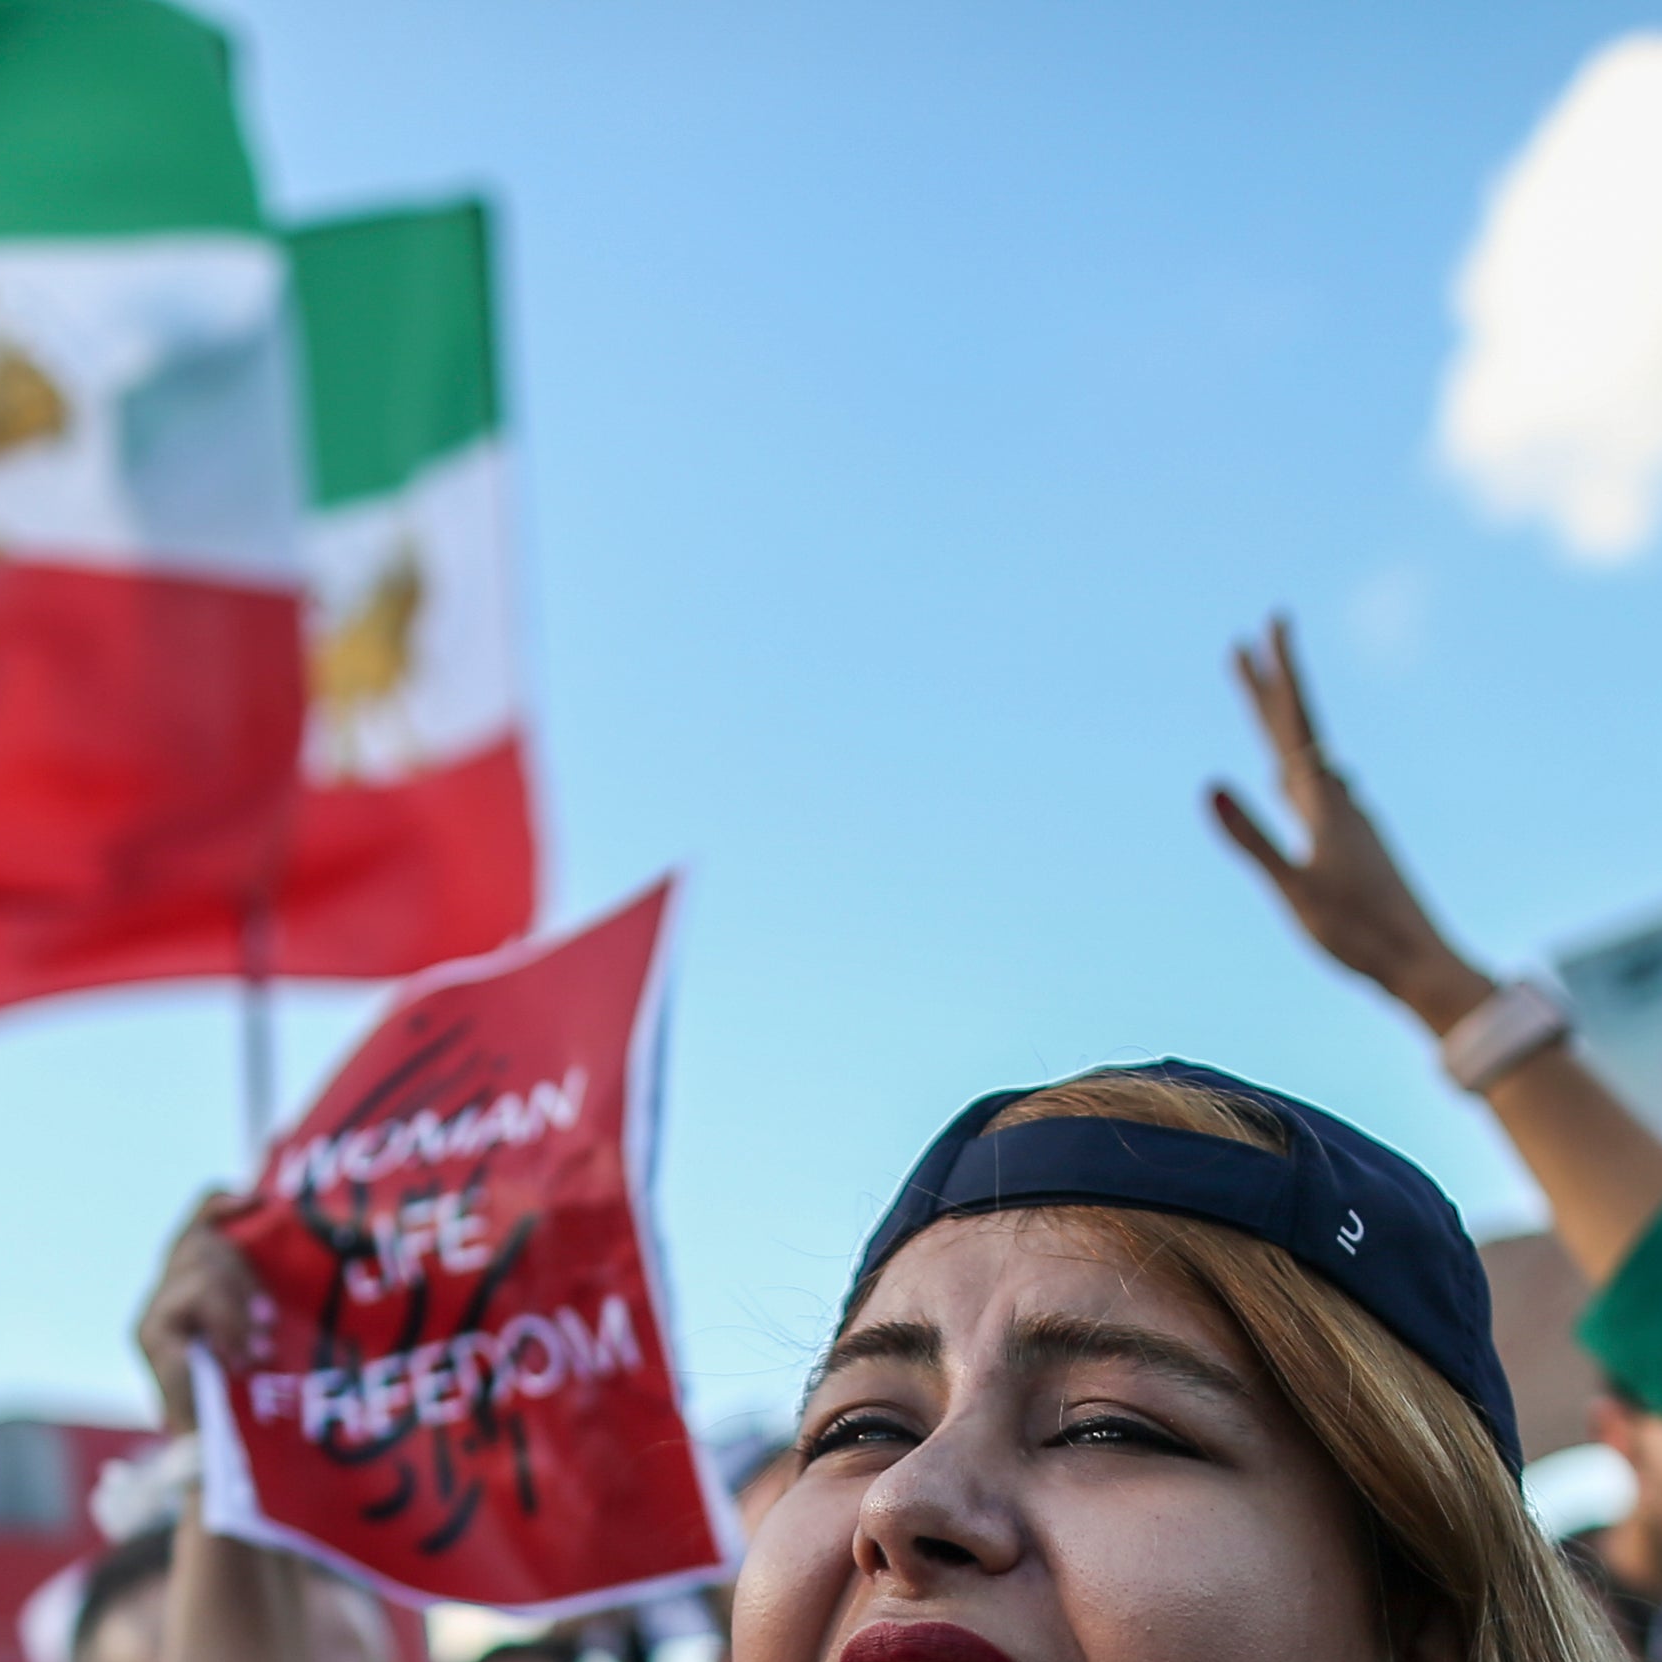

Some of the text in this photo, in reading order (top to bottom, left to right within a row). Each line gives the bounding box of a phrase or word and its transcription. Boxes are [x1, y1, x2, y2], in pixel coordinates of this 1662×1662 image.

[274, 1062, 589, 1202] WOMAN
[342, 1188, 495, 1304] LIFE
[248, 1294, 645, 1444] FREEDOM
